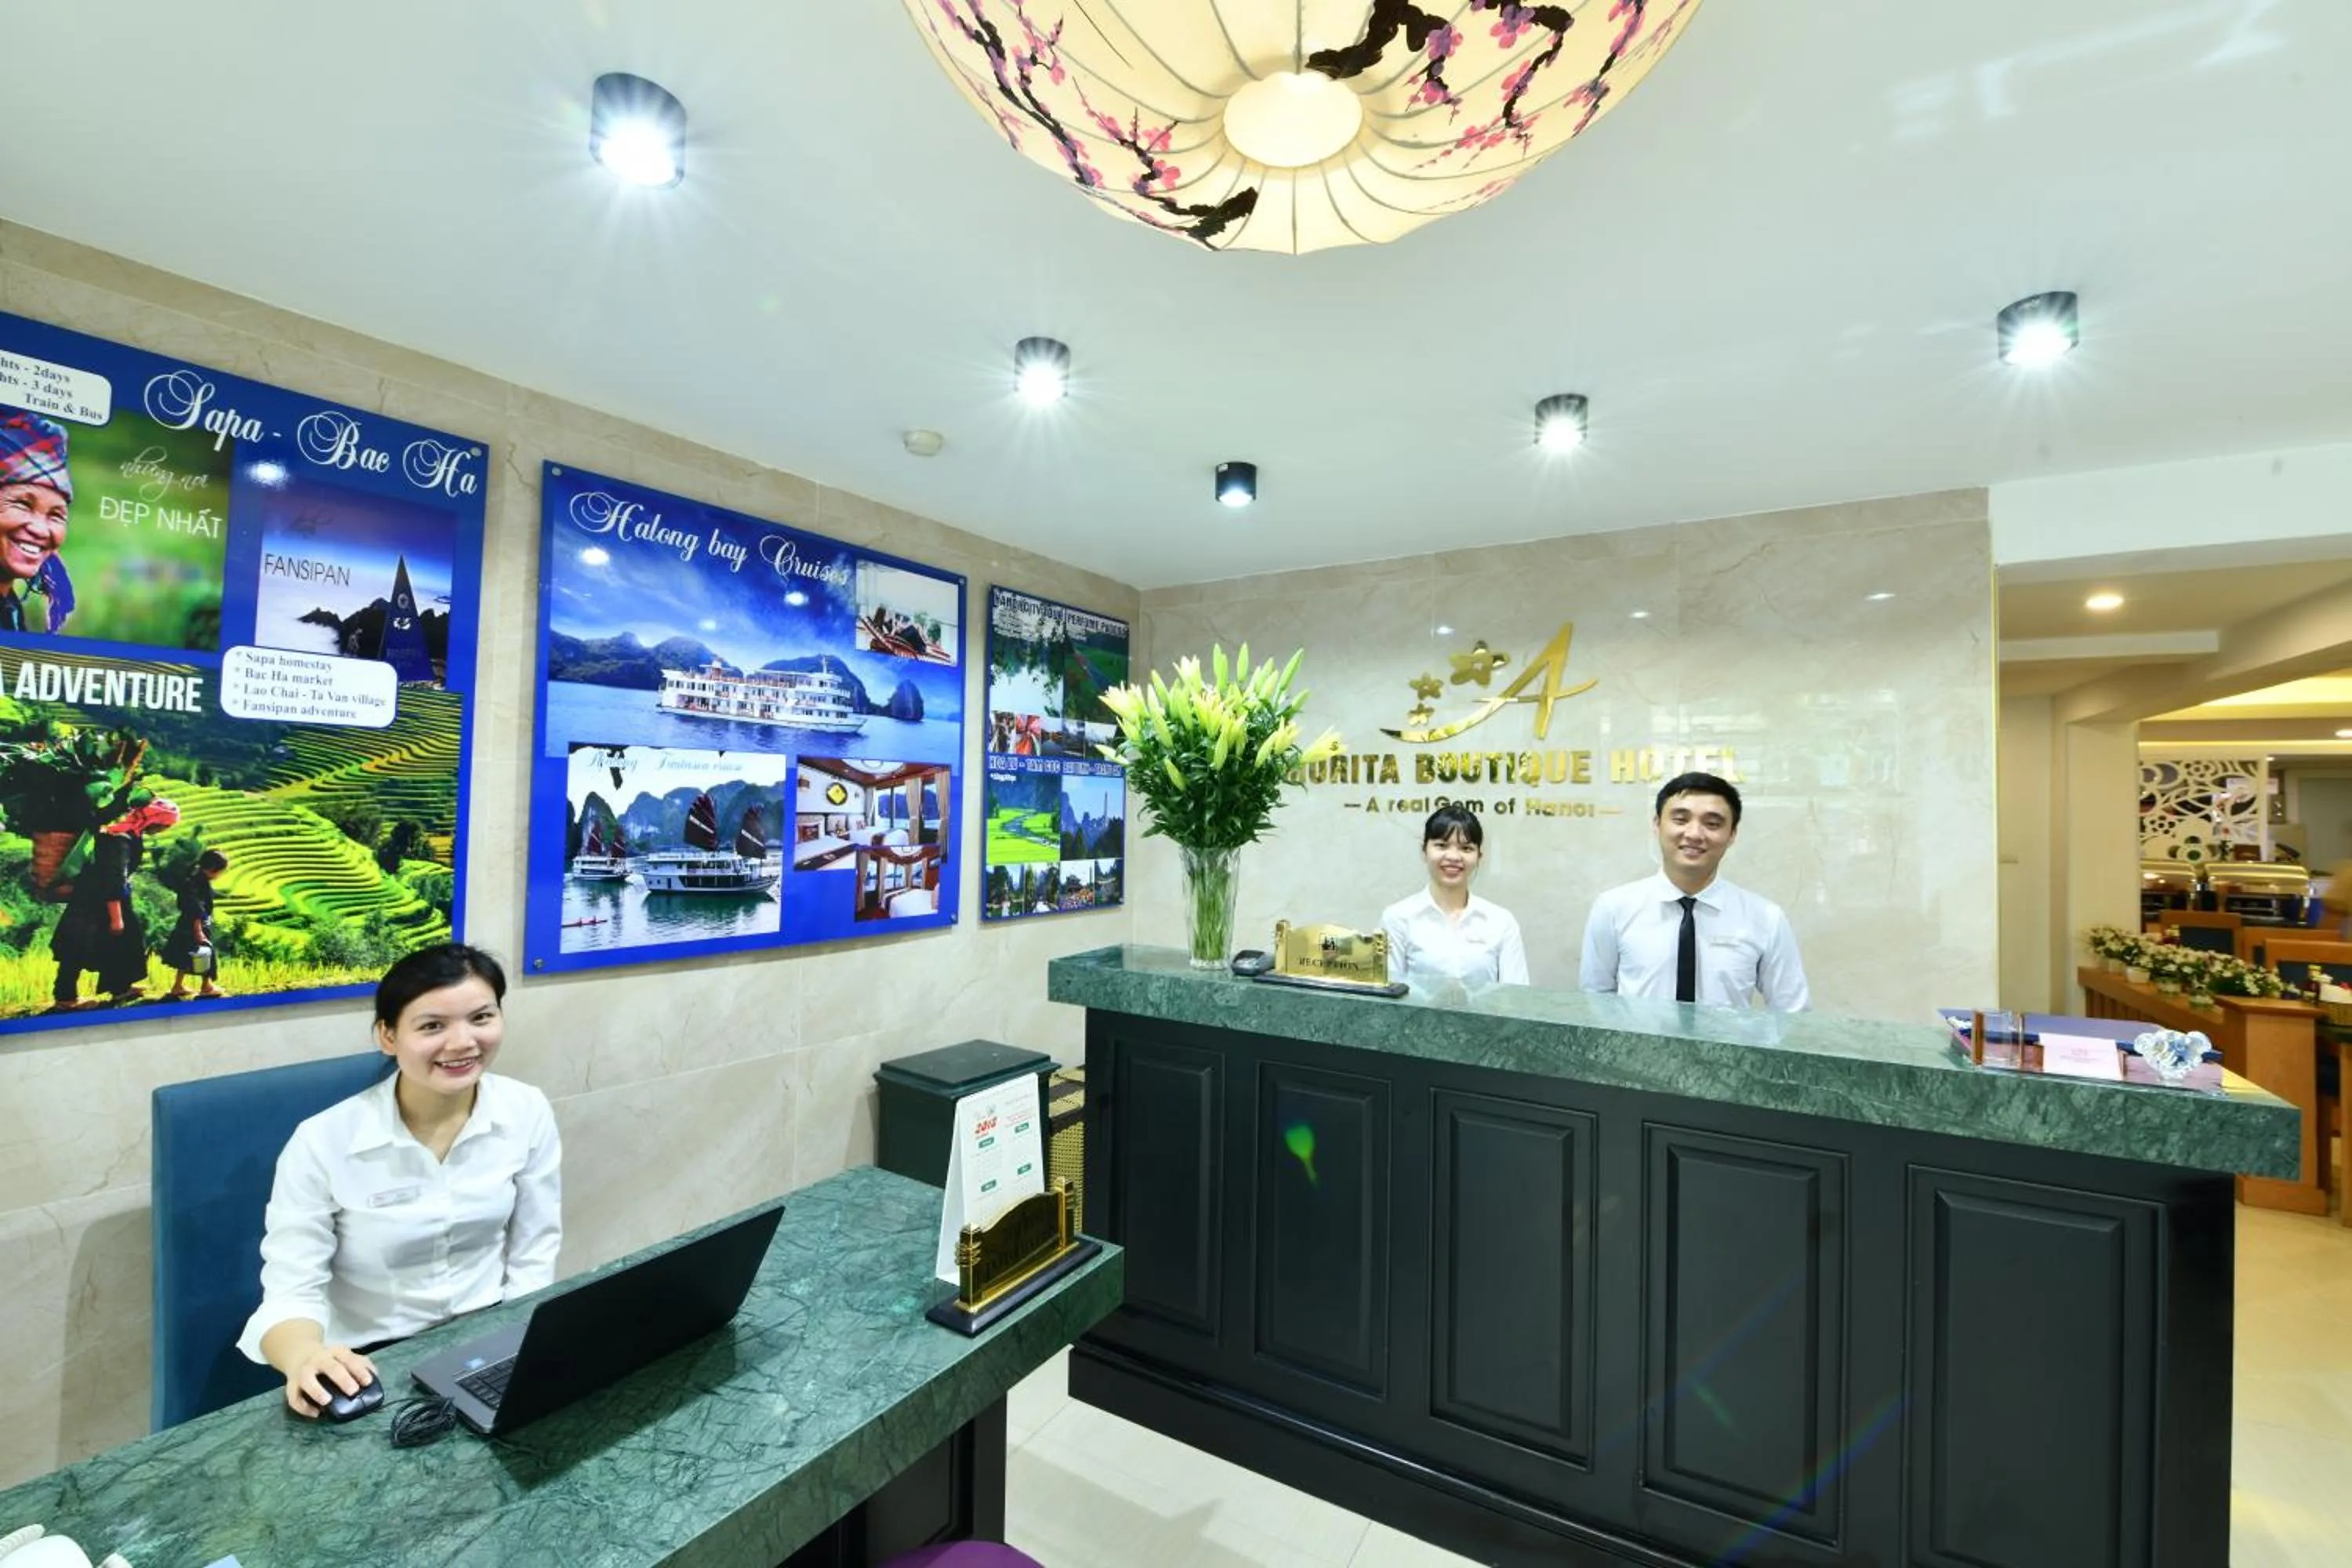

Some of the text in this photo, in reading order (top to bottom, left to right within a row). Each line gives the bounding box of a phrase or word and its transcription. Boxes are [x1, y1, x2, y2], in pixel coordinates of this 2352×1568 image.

[43, 383, 73, 399] days
[26, 393, 103, 419] Train & Bus
[144, 370, 264, 452] Sapa
[297, 411, 390, 473] Bac
[403, 439, 477, 498] Ha
[100, 495, 150, 528] ĐẸP
[570, 492, 850, 586] Halong bay Cruises
[263, 553, 351, 586] FANSIPAN
[245, 651, 332, 672] Sapa homestay
[13, 662, 203, 713] ADVENTURE
[245, 668, 333, 686] Bac Ha market
[243, 684, 267, 696] Lao
[270, 685, 299, 699] Chai
[310, 689, 324, 700] Ta
[327, 691, 349, 703] Van
[352, 695, 387, 707] village
[242, 699, 357, 719] Fansipan adventure
[1415, 750, 1592, 786] BOUTIQUE
[1610, 746, 1746, 784] HOTEL
[1366, 797, 1380, 812] A
[1388, 797, 1429, 812] real
[1494, 797, 1515, 815] of
